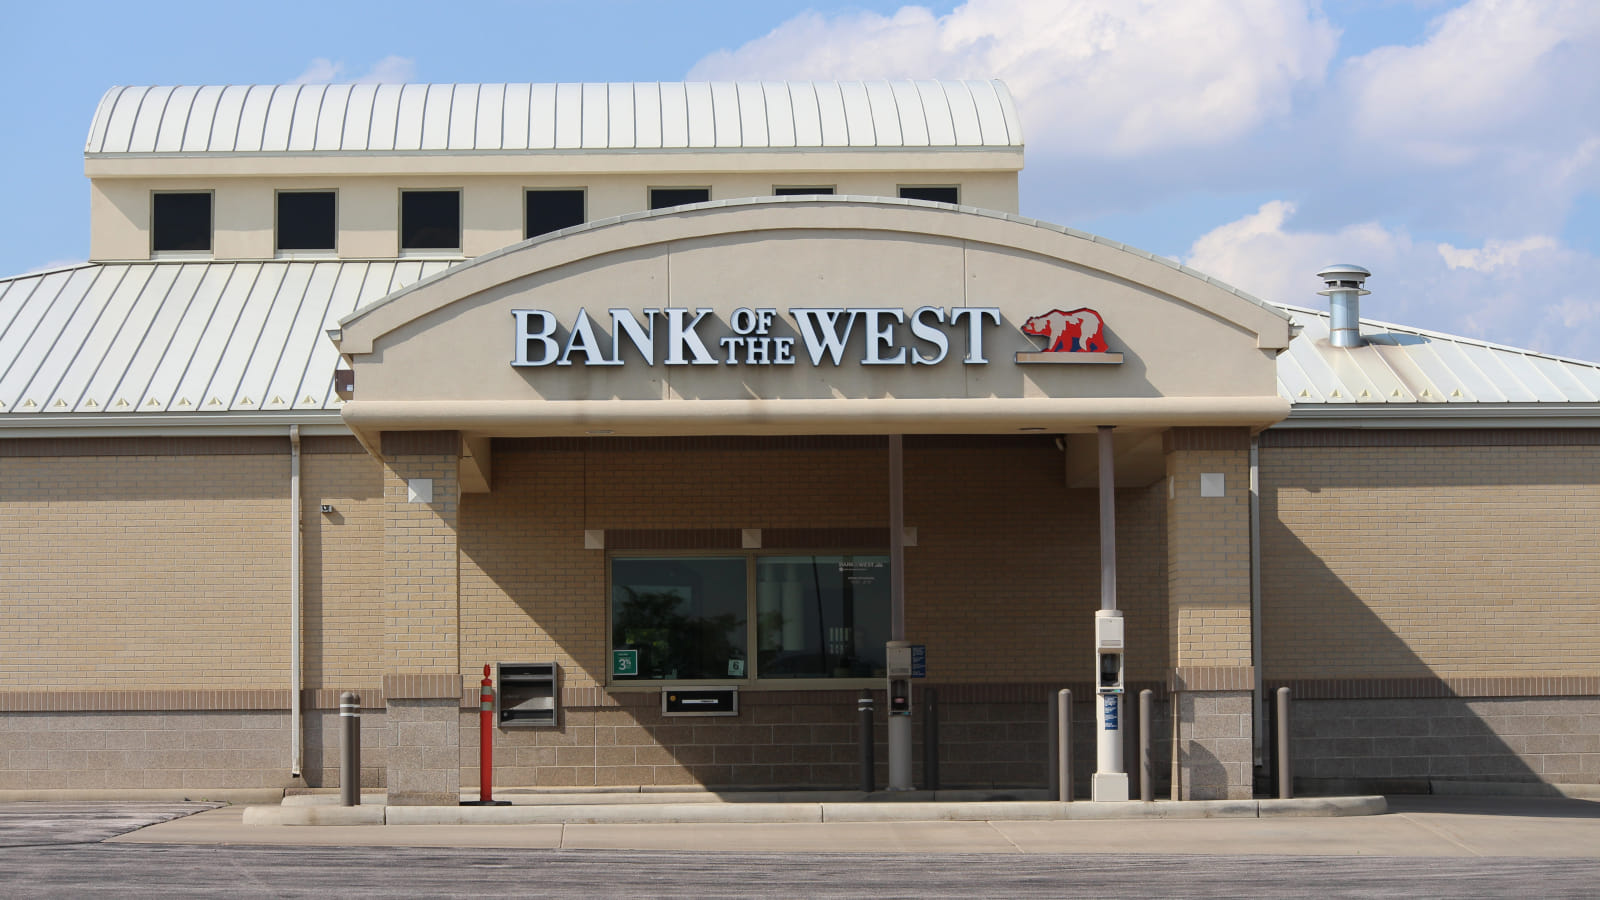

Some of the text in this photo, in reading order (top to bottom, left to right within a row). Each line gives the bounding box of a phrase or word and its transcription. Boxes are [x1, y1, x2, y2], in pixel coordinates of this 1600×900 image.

[511, 306, 1001, 367] BANK OF THE WEST
